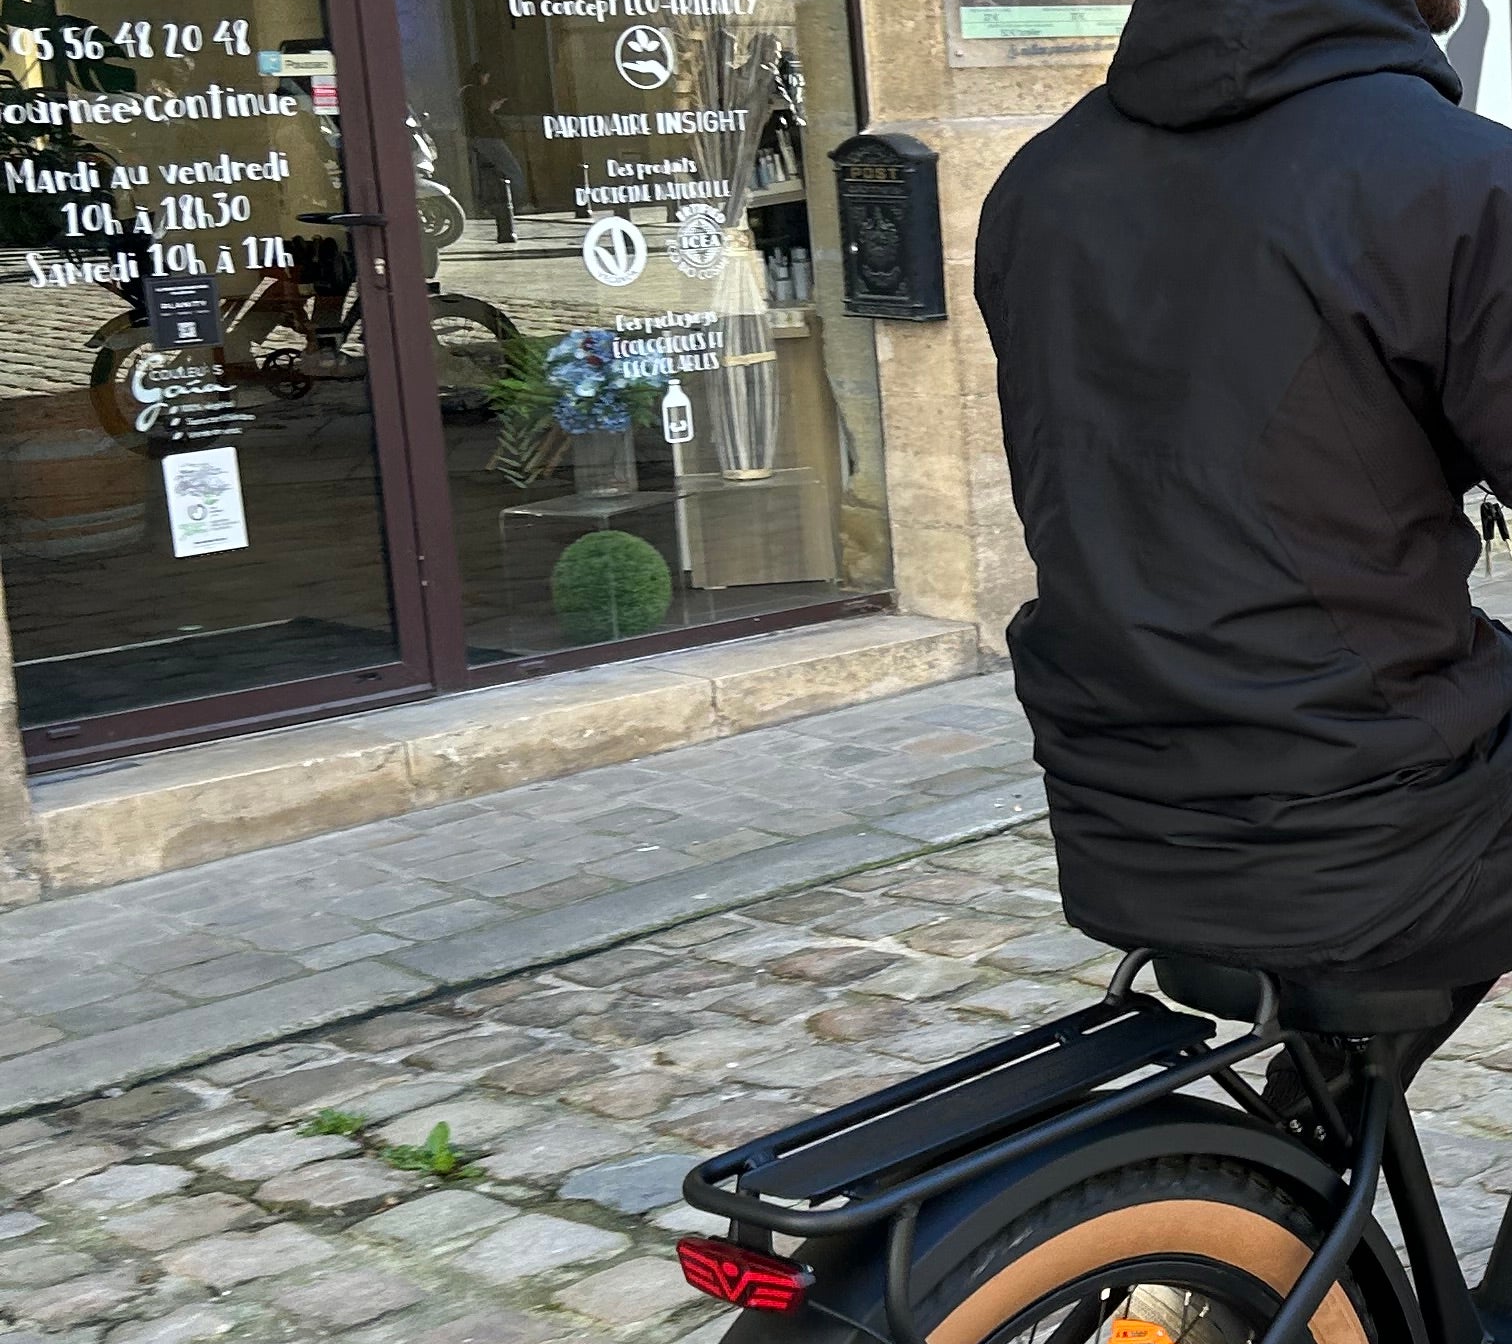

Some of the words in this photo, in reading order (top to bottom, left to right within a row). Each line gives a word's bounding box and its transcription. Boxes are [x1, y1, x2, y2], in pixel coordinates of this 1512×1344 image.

[10, 26, 55, 61] 05
[63, 25, 105, 60] 56
[114, 21, 155, 59] 48
[162, 23, 204, 59] 20
[213, 19, 252, 57] 48
[0, 94, 134, 126] ournée
[143, 83, 299, 124] Continue
[543, 111, 653, 140] PARTENAIRE
[655, 109, 750, 136] INSIGHT
[4, 157, 102, 195] Mardi
[158, 151, 290, 186] vendredi
[606, 159, 636, 178] Des
[851, 166, 899, 181] POST
[60, 201, 125, 238] 10h
[160, 192, 252, 231] 18h30
[25, 251, 141, 289] Samedi
[147, 243, 208, 278] 10h
[242, 235, 296, 270] 17h
[682, 233, 722, 250] ICEA
